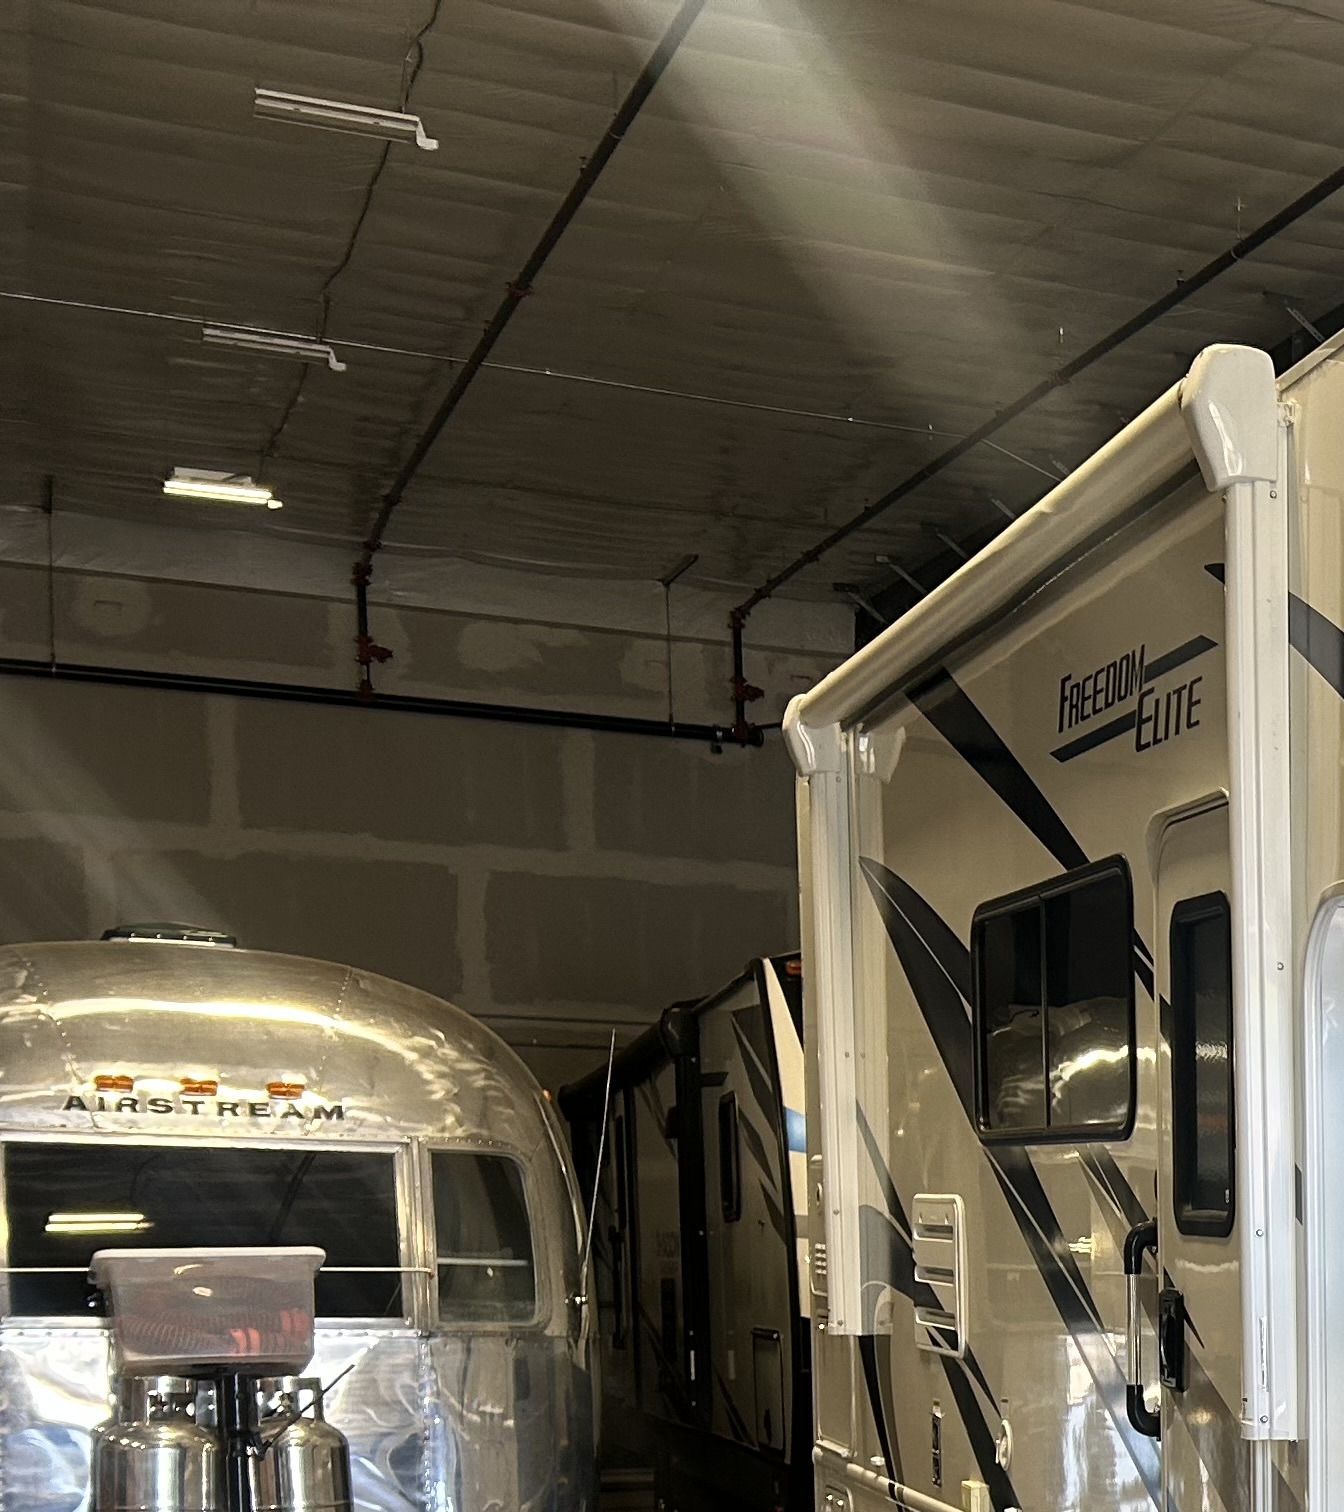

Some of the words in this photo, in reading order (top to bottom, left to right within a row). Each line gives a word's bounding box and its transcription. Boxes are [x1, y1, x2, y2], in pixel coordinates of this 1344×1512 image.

[1058, 644, 1145, 734] FREEDOM
[1135, 675, 1203, 753] ELITE
[62, 1095, 346, 1121] AIRSTREAM
